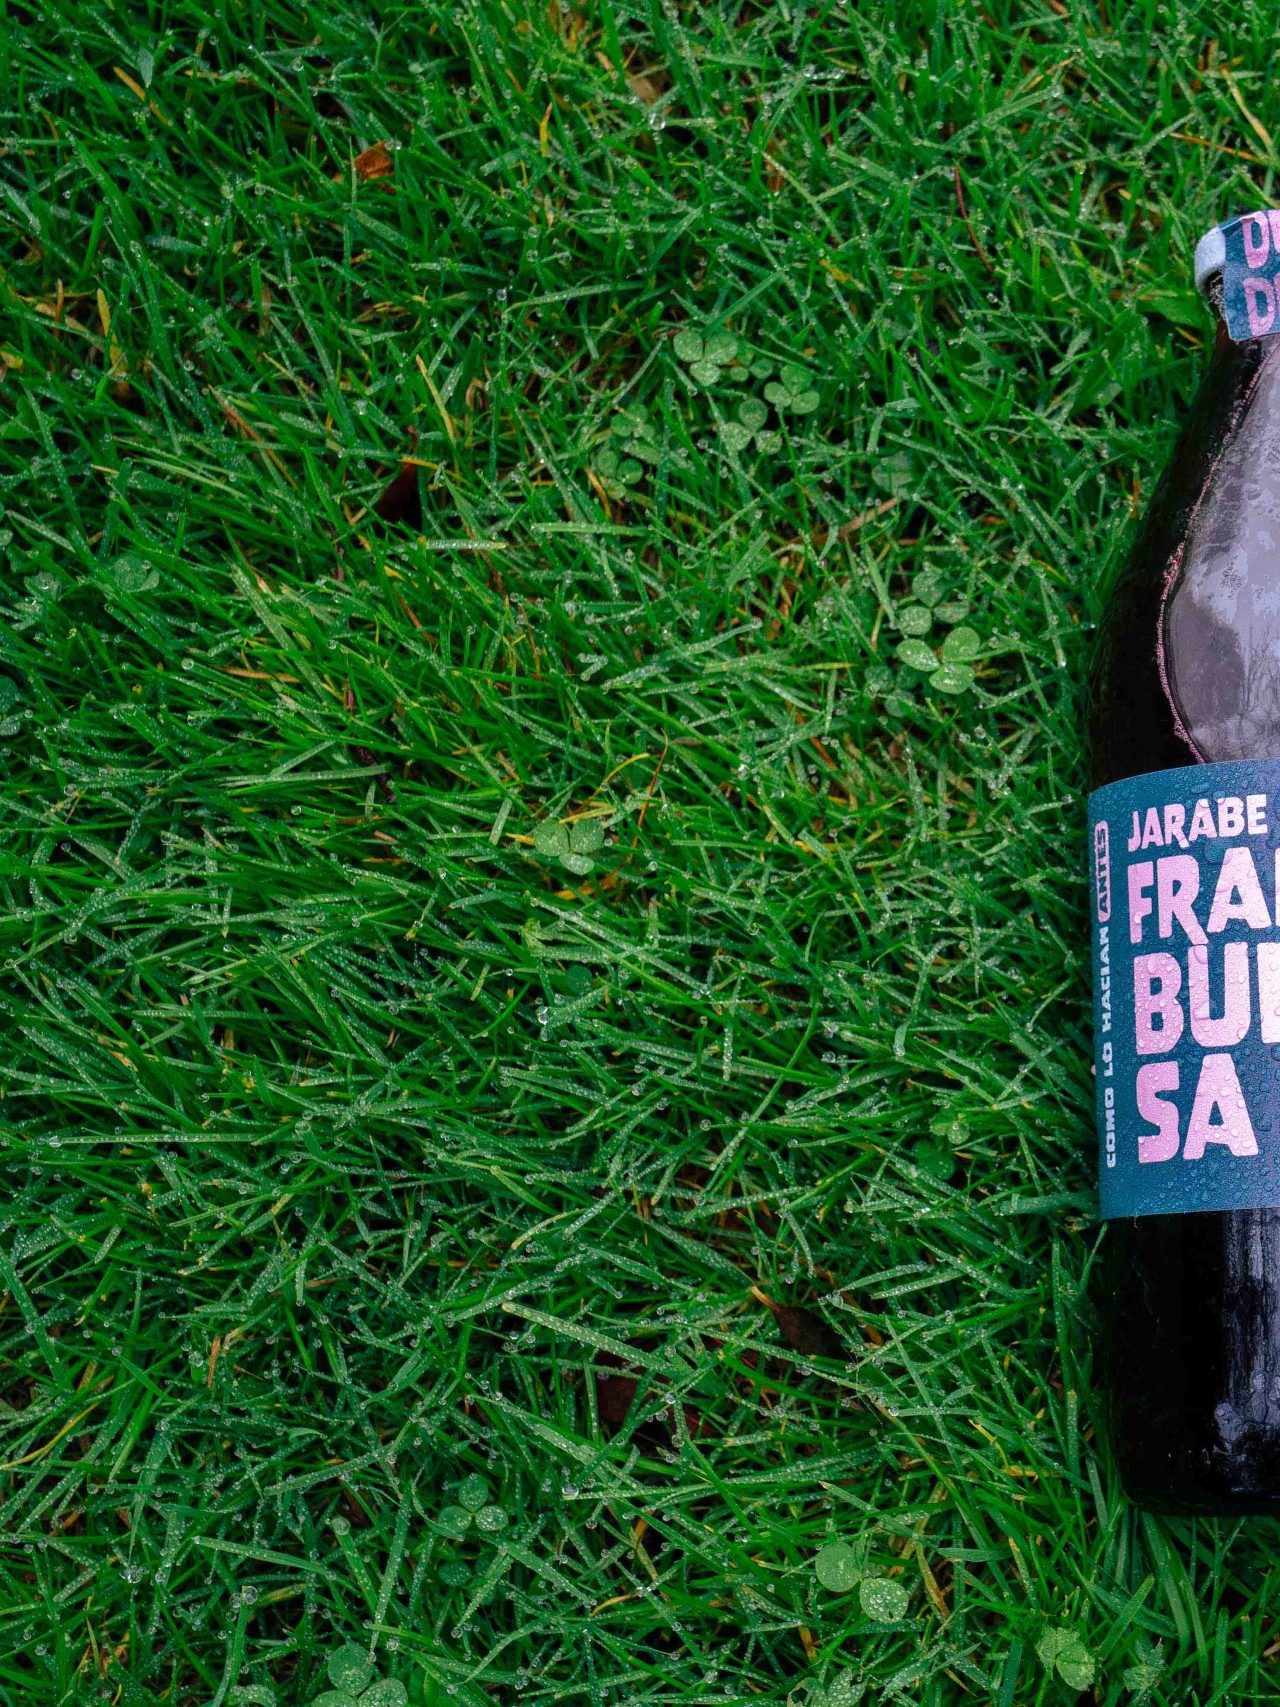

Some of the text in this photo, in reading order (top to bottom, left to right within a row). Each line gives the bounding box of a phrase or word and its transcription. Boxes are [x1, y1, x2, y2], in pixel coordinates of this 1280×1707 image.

[1127, 793, 1268, 852] JARABE
[1096, 825, 1116, 1168] COMO LO HACIAN ANTES
[1135, 1053, 1259, 1164] SA
